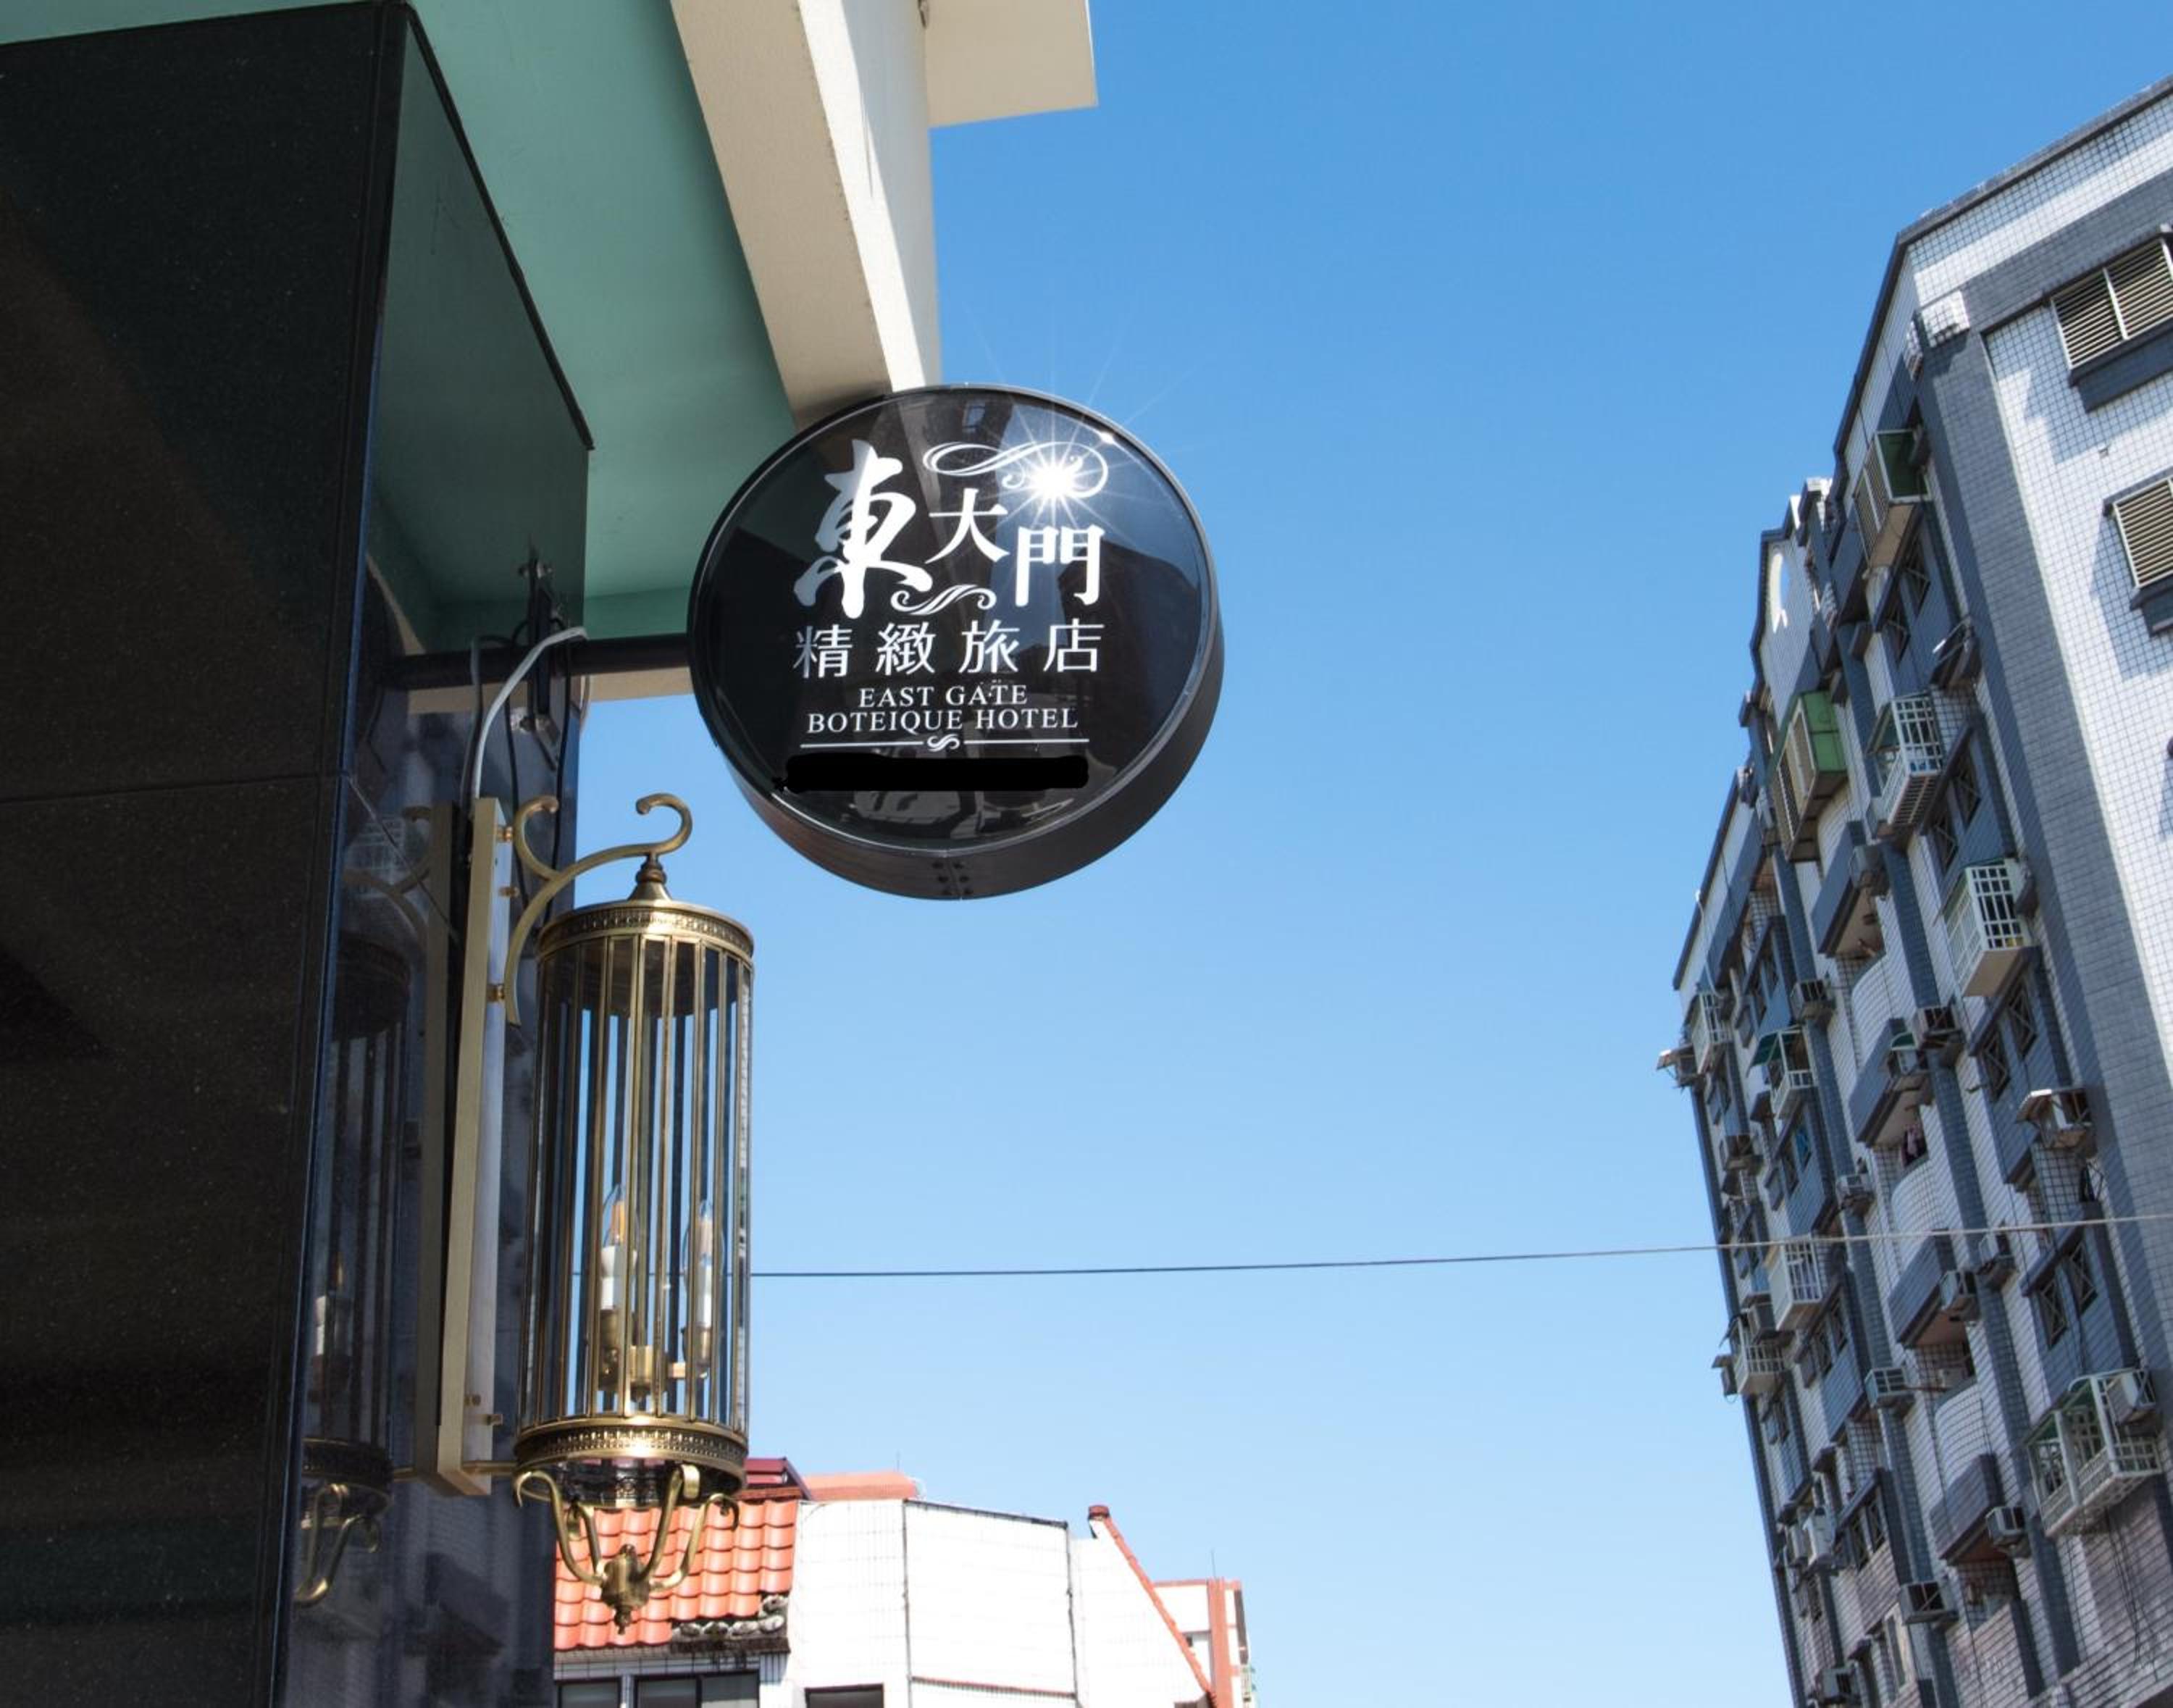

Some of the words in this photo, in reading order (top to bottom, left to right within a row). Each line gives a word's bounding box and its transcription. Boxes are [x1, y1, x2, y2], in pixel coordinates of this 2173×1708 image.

[794, 439, 1105, 619] 東大門
[793, 618, 1105, 679] 精緻旅店
[858, 686, 934, 708] EAST
[945, 685, 1028, 706] GATE
[807, 709, 963, 735] BOTEIQUE
[975, 708, 1079, 729] HOTEL
